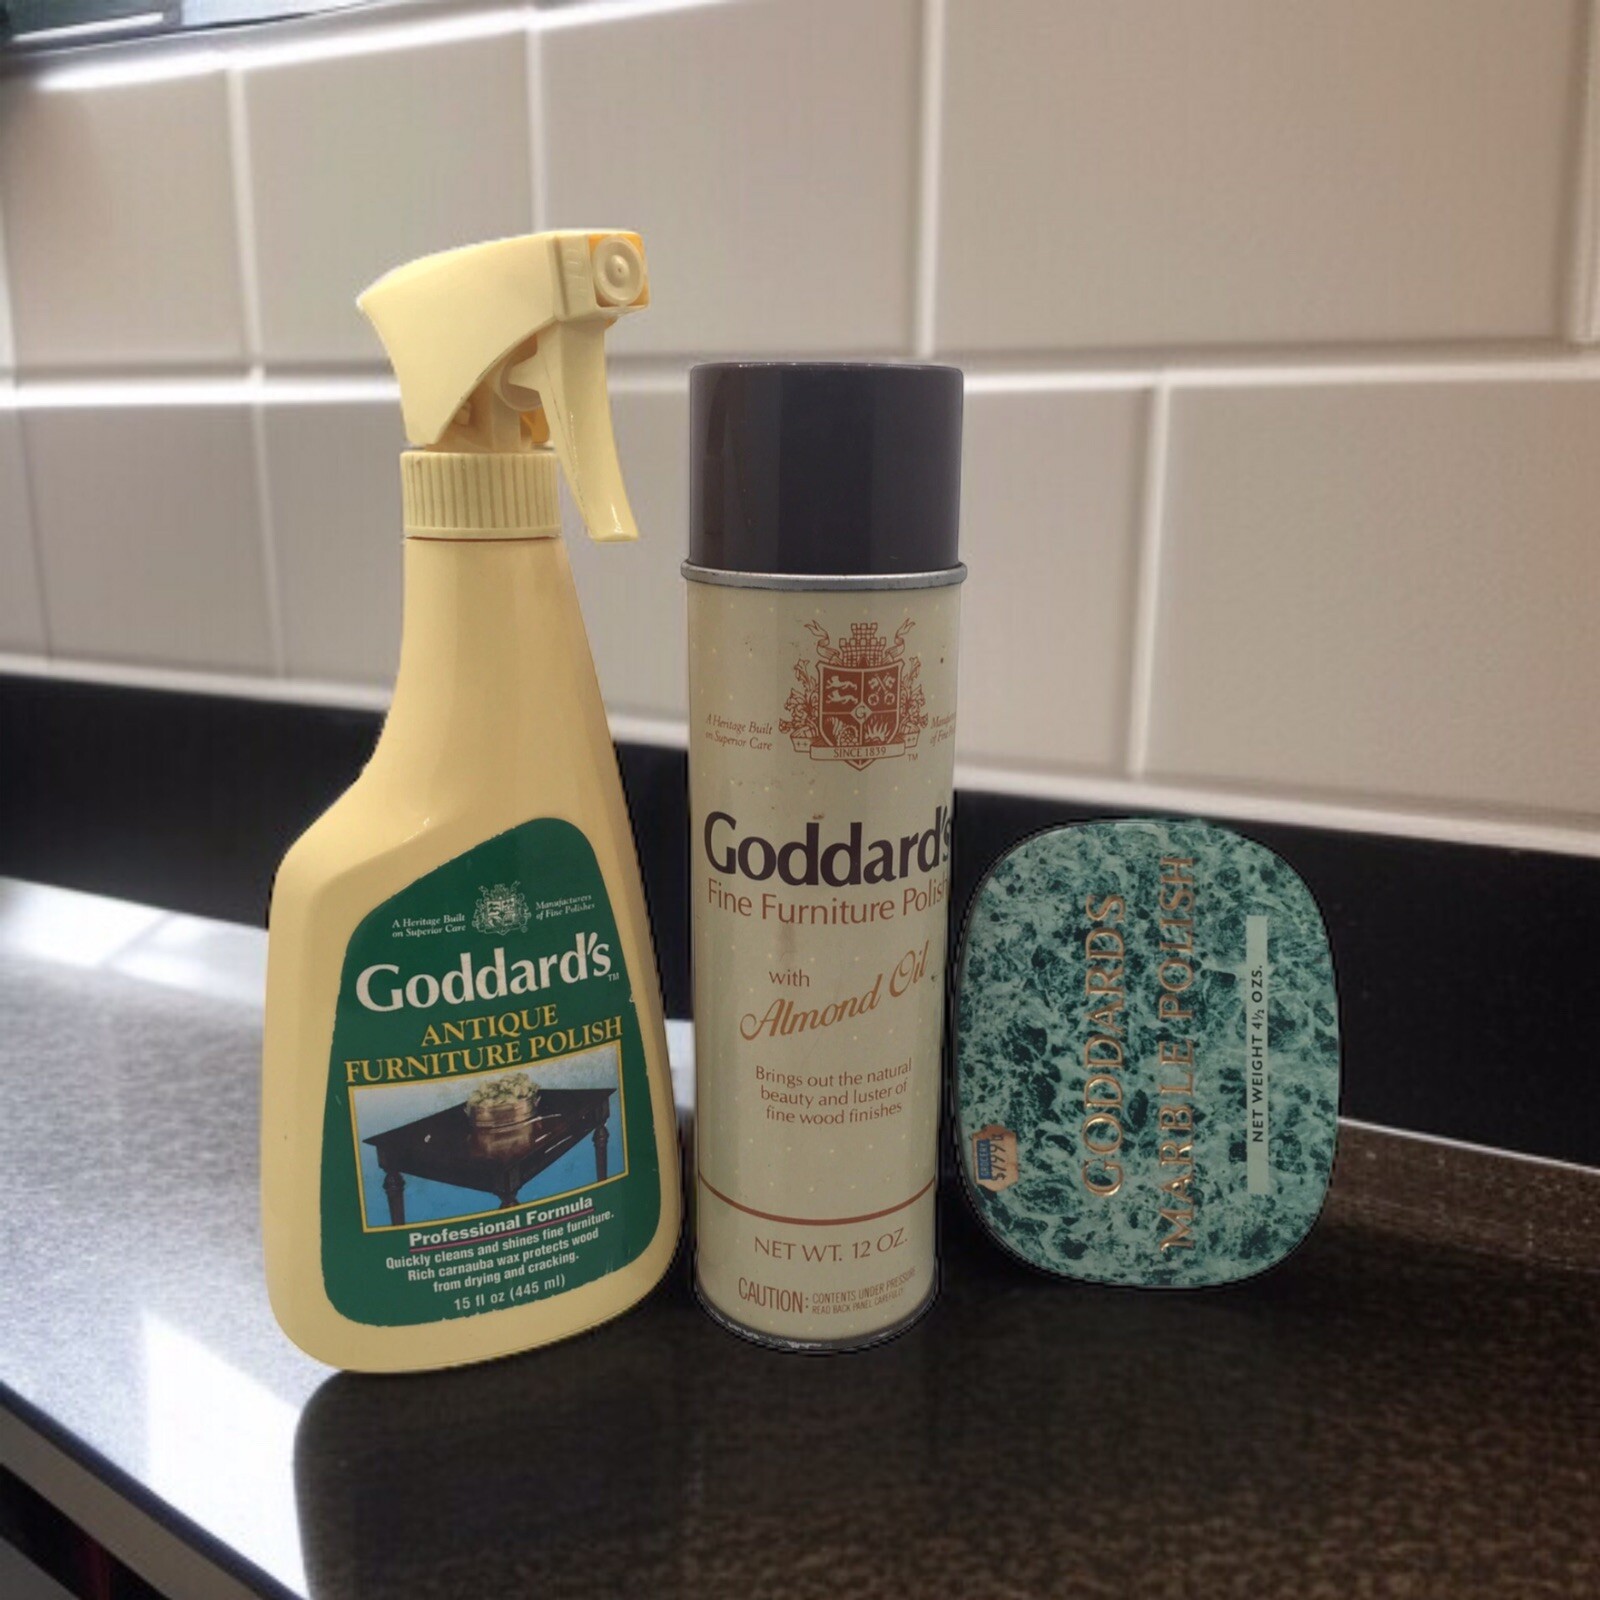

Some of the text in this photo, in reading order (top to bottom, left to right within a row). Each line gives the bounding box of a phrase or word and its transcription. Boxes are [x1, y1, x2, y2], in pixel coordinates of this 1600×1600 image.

[749, 720, 773, 735] Built
[750, 736, 773, 750] Care
[865, 747, 887, 758] 1839
[907, 754, 919, 762] TM
[704, 806, 950, 887] Goddard's
[535, 894, 592, 911] Manufacturers
[535, 902, 595, 921] of Fine Polishes
[708, 877, 752, 917] Fine
[761, 893, 895, 925] Furniture
[392, 913, 465, 929] A Heritage Built
[392, 923, 466, 938] on Superior Care
[355, 931, 612, 1013] Goddard's
[608, 972, 620, 982] TM
[740, 939, 929, 1041] Almond Oil
[768, 968, 810, 987] with
[1251, 965, 1263, 1003] OZS.
[421, 1004, 558, 1047] ANTIQUE
[344, 1015, 623, 1084] FURNITURE POLISH
[1081, 894, 1126, 1198] GODDARDS
[1159, 856, 1196, 1253] MARBLE POLISH
[755, 1057, 912, 1087] Brings out the natural
[1251, 1034, 1263, 1103] WEIGHT
[760, 1078, 908, 1109] beauty and luster of
[766, 1102, 903, 1125] fine wood finishes
[1252, 1109, 1264, 1142] NET
[409, 1196, 593, 1247] Professional Formula
[386, 1211, 615, 1270] Quickly cleans and shines fine furniture.
[408, 1228, 599, 1282] Rich carnauba wax protects wood
[754, 1227, 908, 1262] NET WT. 12 OZ.
[433, 1252, 580, 1293] from drying and cracking.
[812, 1266, 916, 1304] CONTENTS UNDER PRESSURE
[453, 1274, 566, 1311] 15 fl oz (445 ml)
[738, 1276, 809, 1314] CAUTION:
[812, 1305, 831, 1315] READ
[833, 1303, 851, 1315] BACK
[853, 1300, 873, 1312] PANEL
